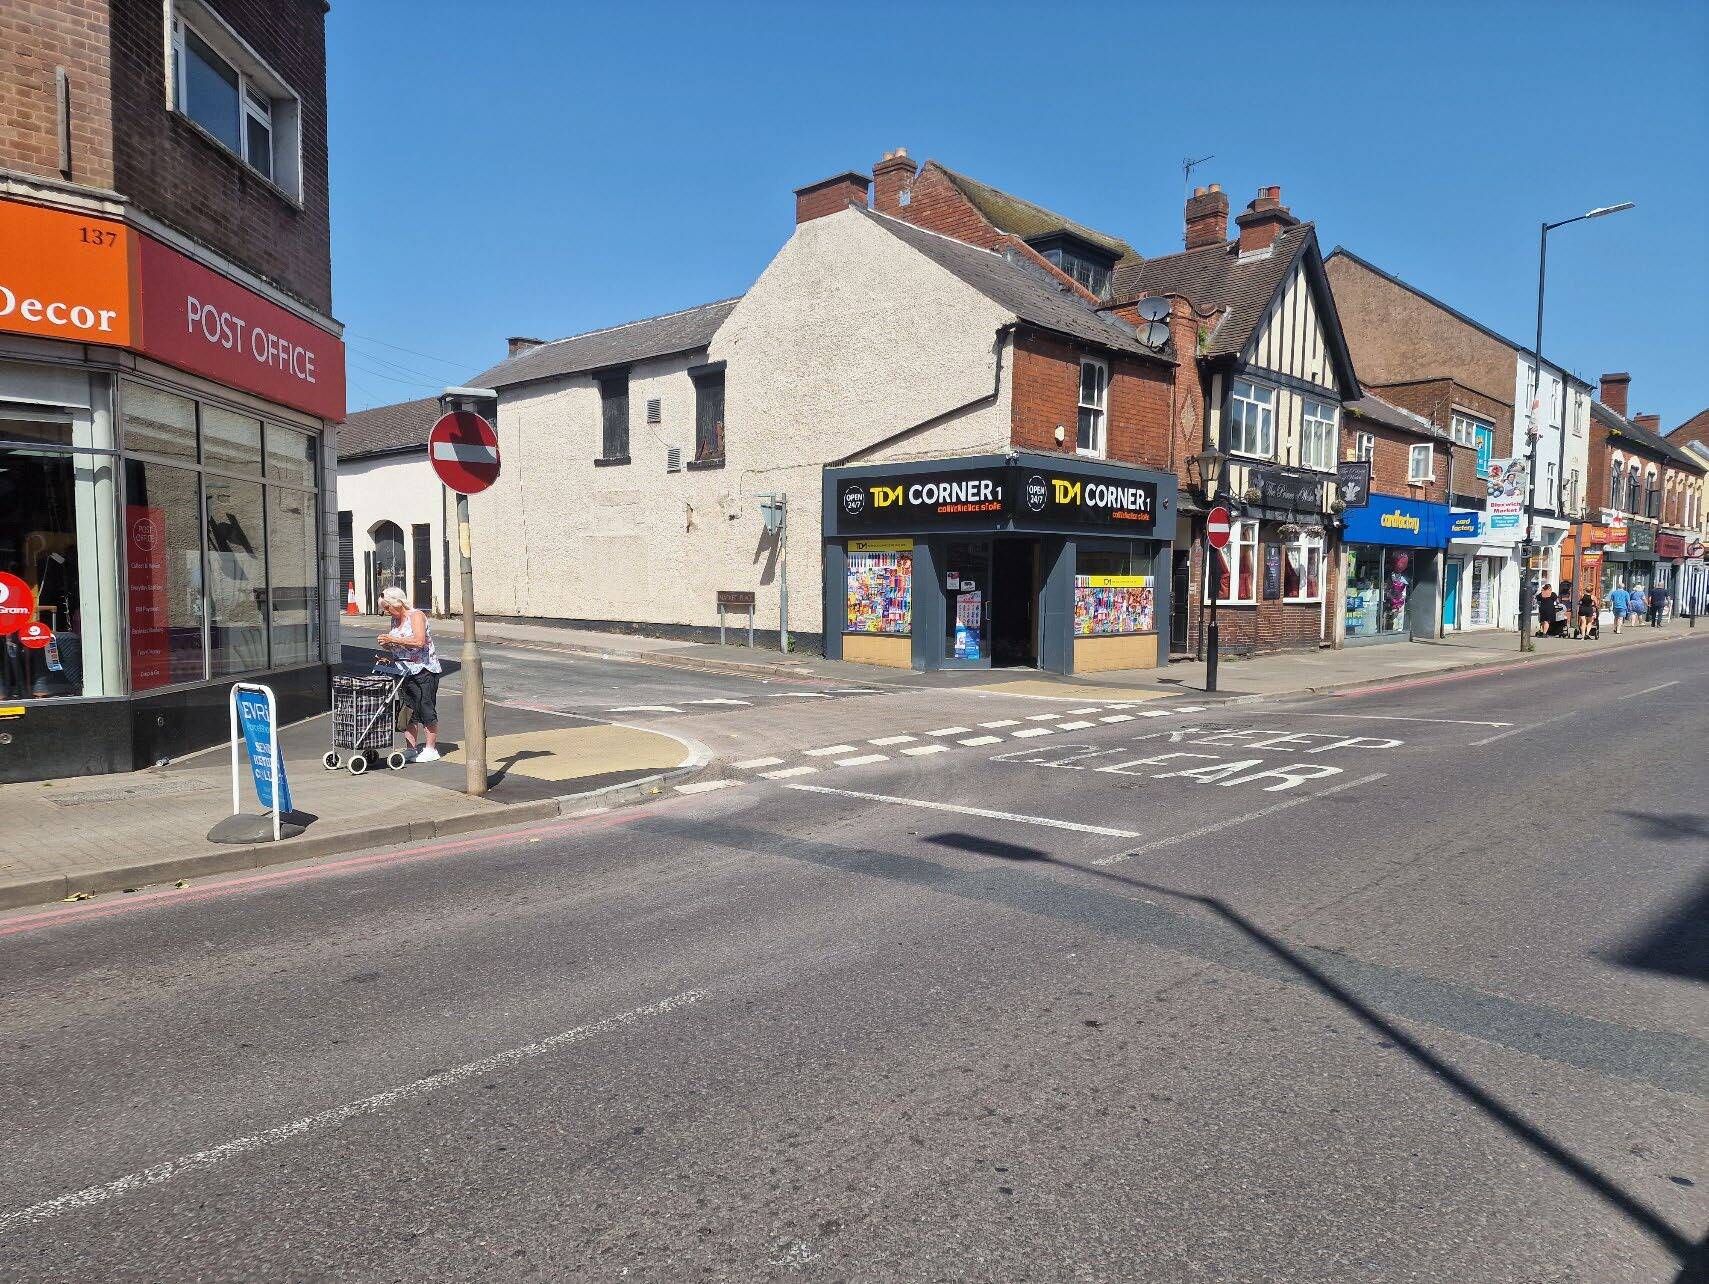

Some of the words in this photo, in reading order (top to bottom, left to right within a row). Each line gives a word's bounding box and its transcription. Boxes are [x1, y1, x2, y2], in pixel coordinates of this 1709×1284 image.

[80, 226, 117, 248] 137
[187, 295, 246, 353] POST
[252, 327, 316, 384] OFFICE
[846, 493, 863, 501] OPEN
[908, 480, 993, 505] CORNER
[995, 486, 1002, 501] 1
[1028, 485, 1045, 495] OPEN
[1030, 495, 1043, 504] 24/7
[1084, 483, 1145, 511] CORNER
[1146, 498, 1151, 512] 1
[847, 501, 861, 509] 24/7
[987, 744, 1344, 792] CLEAR
